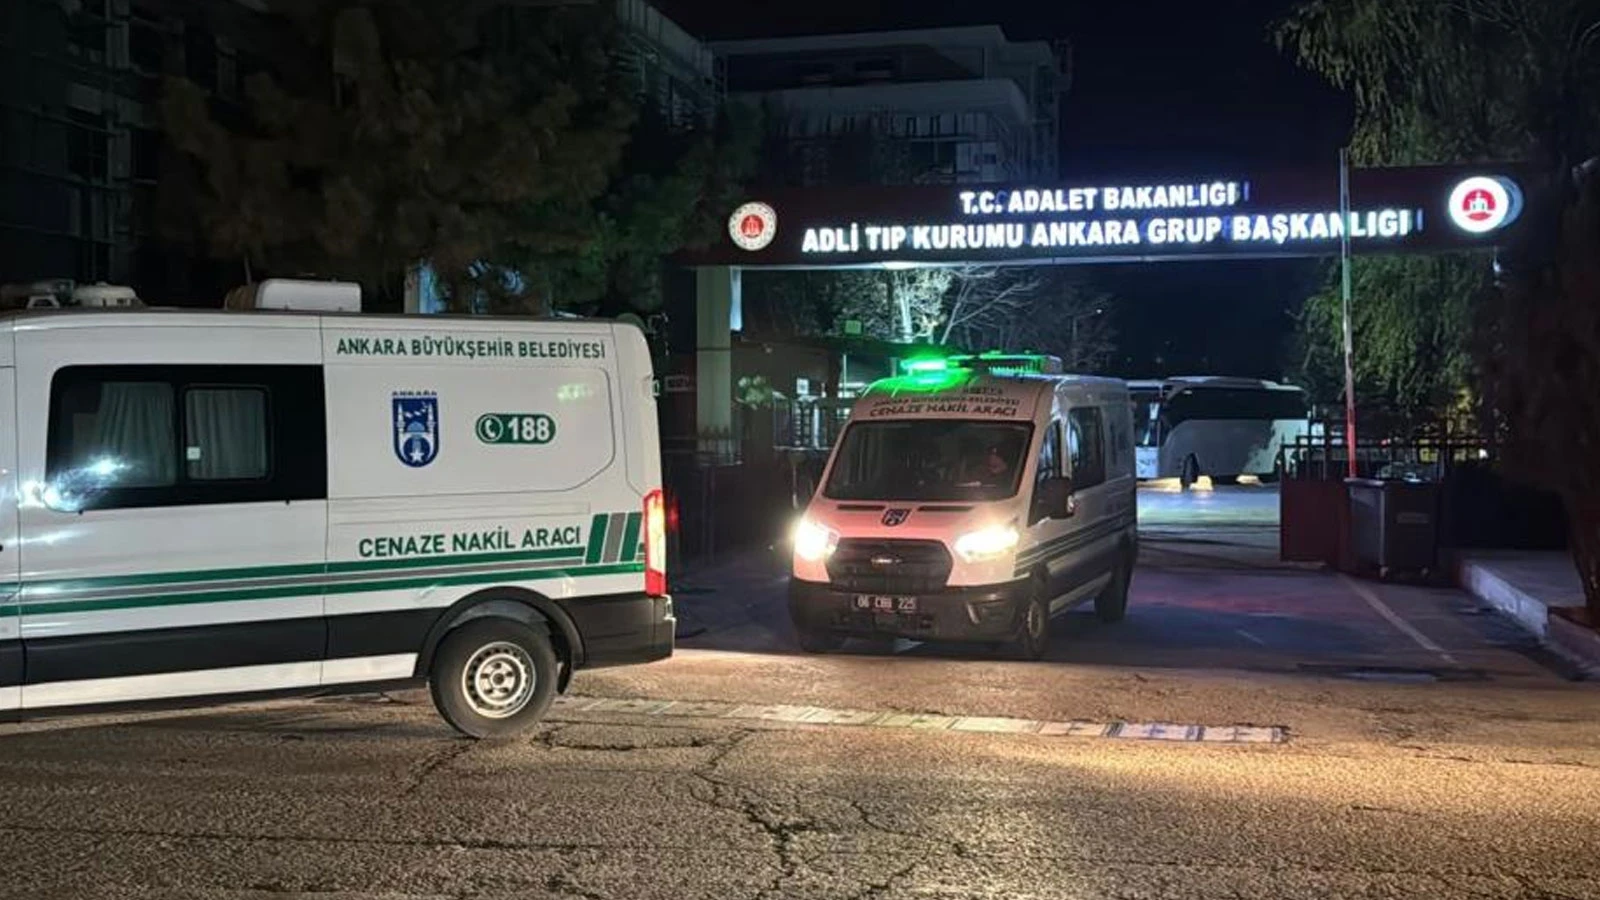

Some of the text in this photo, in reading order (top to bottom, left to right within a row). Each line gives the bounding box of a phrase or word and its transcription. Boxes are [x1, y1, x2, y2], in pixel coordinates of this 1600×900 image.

[960, 192, 1001, 213] T.C.
[1008, 187, 1099, 212] ADALET
[802, 223, 858, 252] ADLİ
[866, 227, 906, 251] TIP
[913, 223, 1023, 250] KURUMU
[1032, 218, 1140, 247] ANKARA
[1147, 216, 1222, 244] GRUP
[337, 336, 605, 359] ANKARA BÜYÜKŞEHİR BELEDİYESİ
[970, 406, 1017, 417] ARACI
[508, 416, 551, 442] 188
[359, 526, 581, 558] CENAZE NAKİL ARACI
